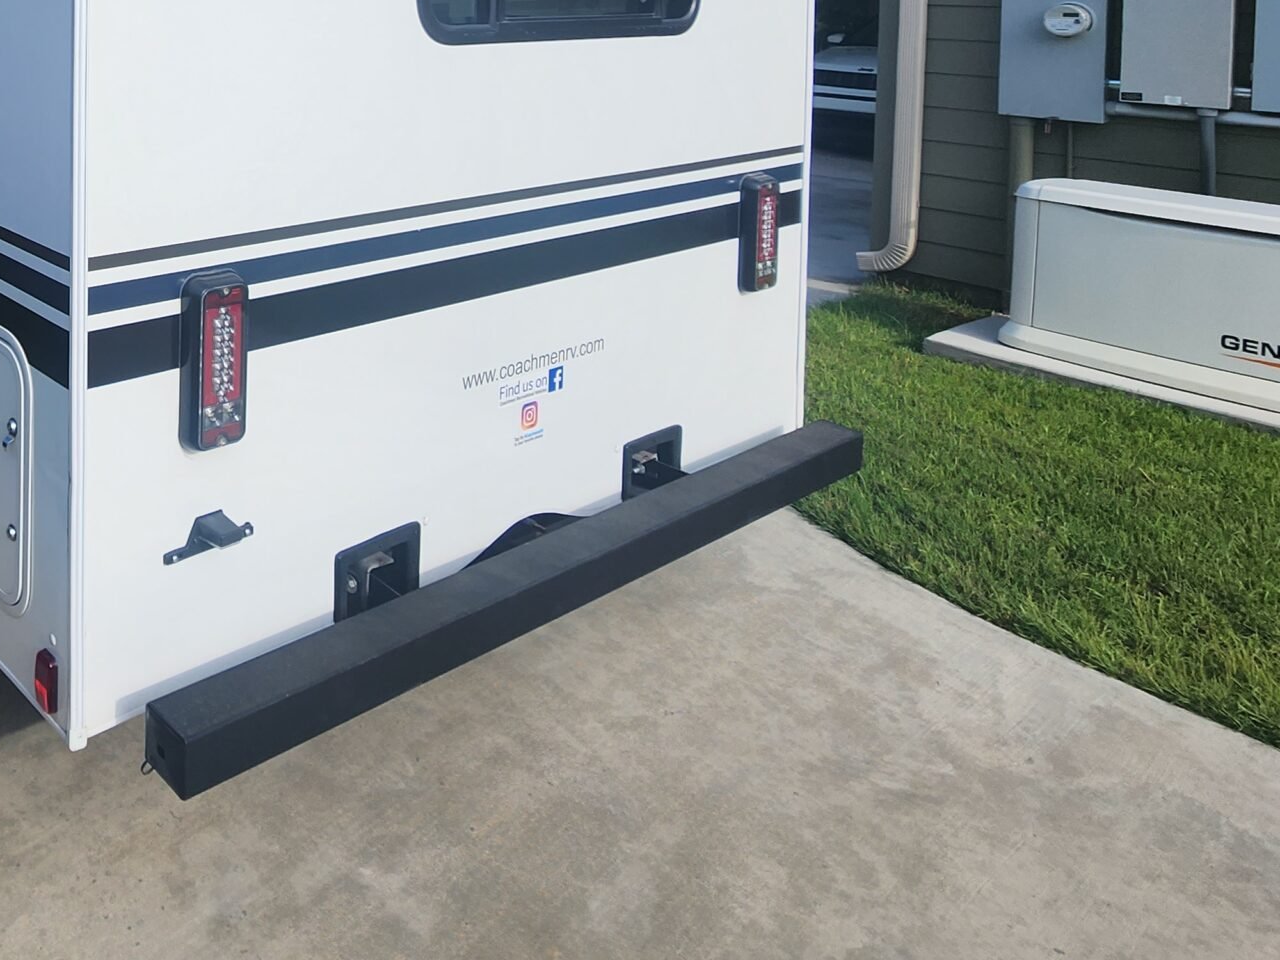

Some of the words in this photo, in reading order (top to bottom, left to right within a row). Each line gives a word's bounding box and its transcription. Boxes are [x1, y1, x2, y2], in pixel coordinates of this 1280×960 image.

[462, 337, 605, 390] www.coachmenrv.com
[499, 379, 521, 400] Find
[522, 380, 534, 393] us
[535, 376, 548, 388] on
